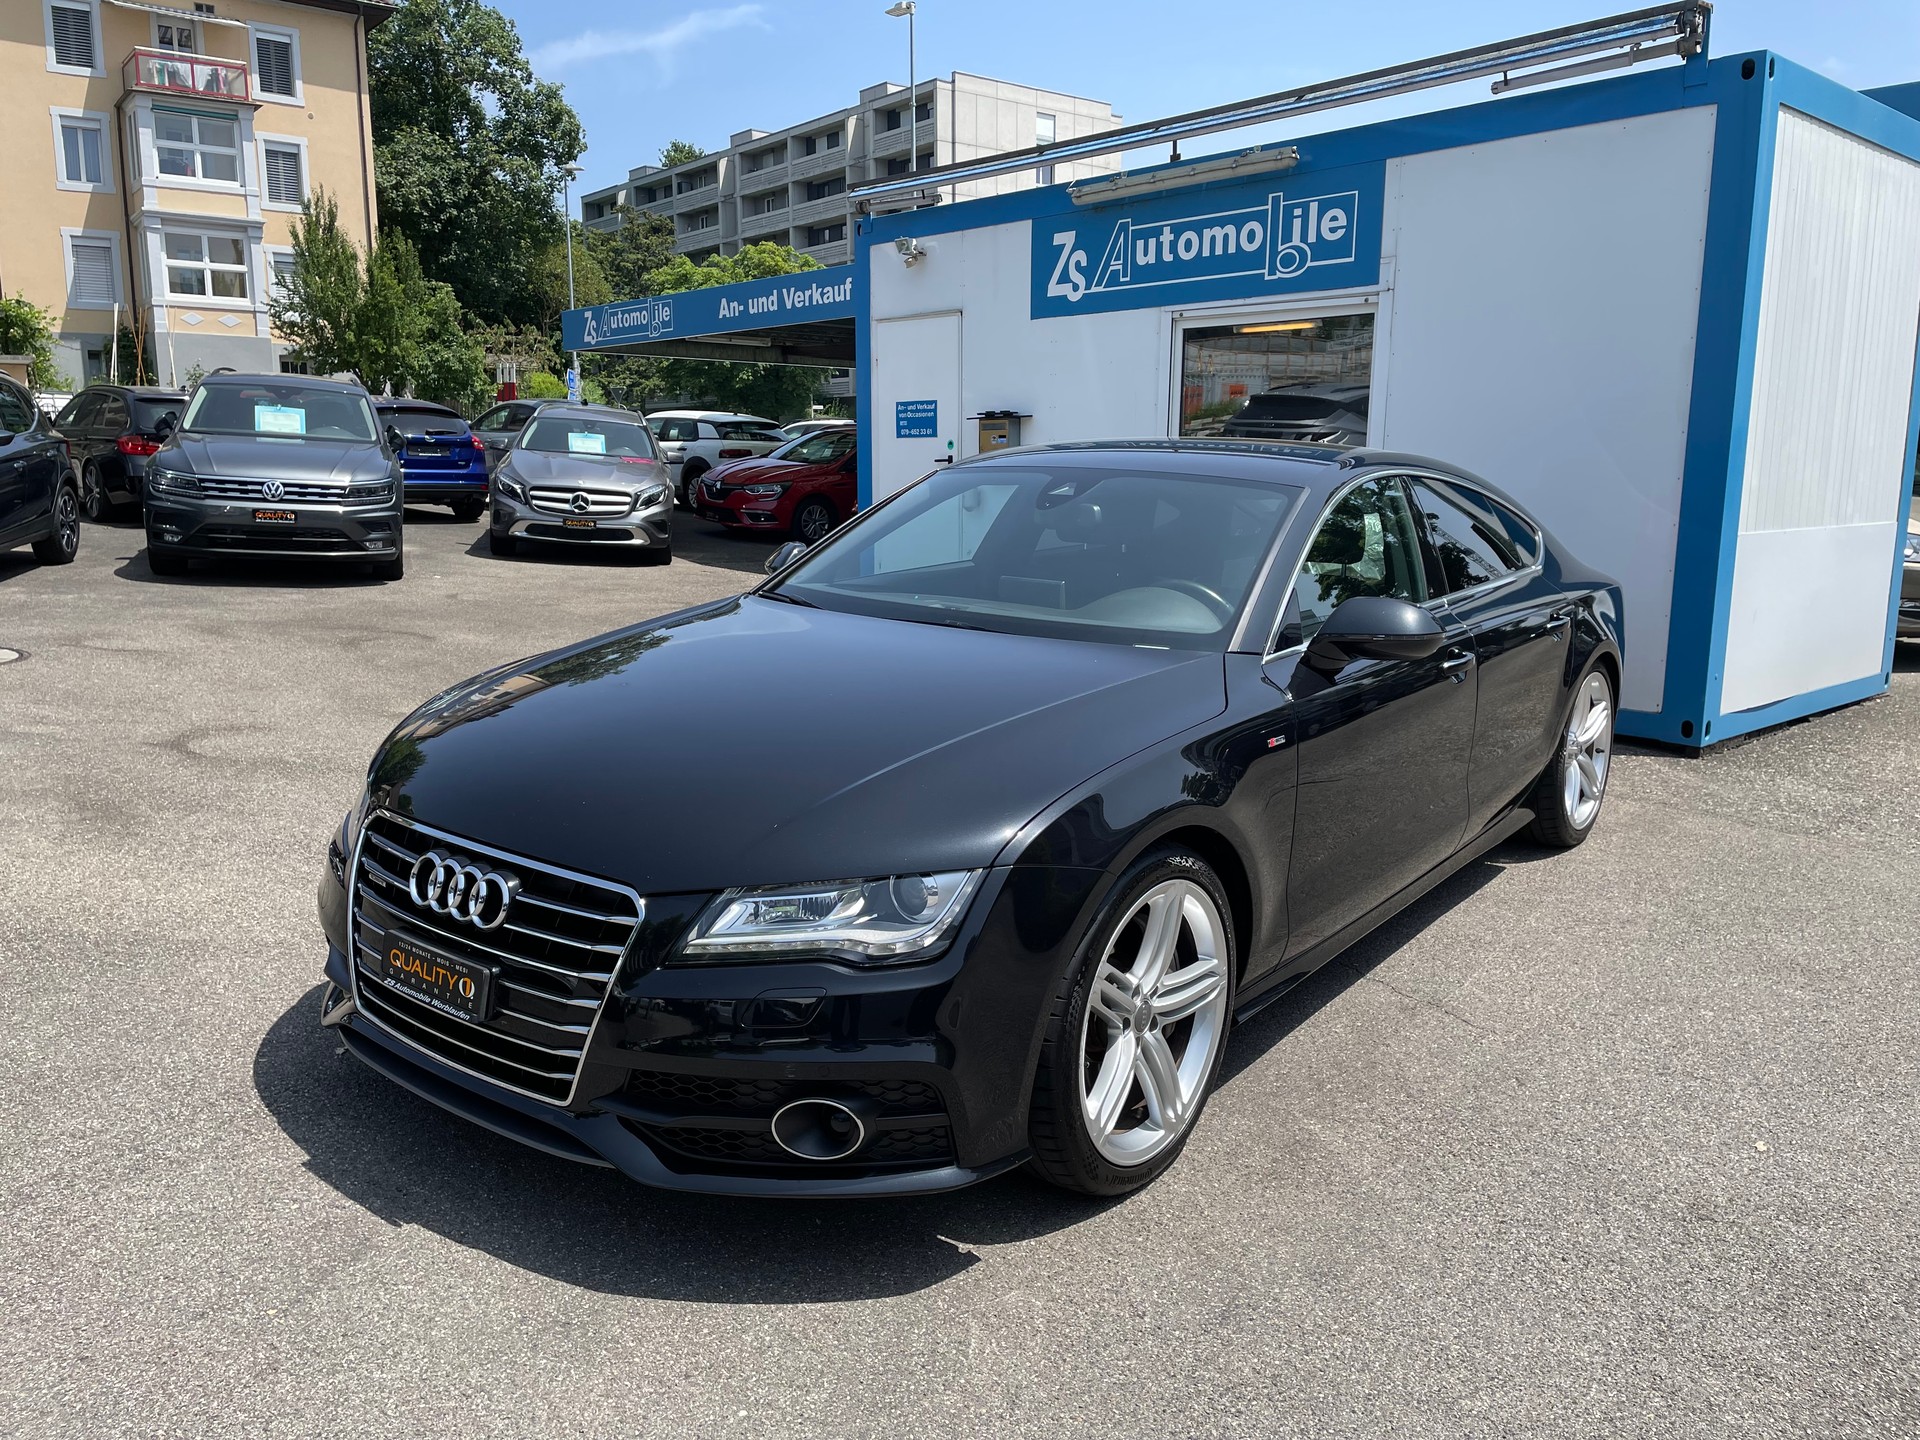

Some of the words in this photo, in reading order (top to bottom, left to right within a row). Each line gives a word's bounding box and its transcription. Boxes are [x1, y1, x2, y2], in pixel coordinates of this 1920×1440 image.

[1089, 191, 1348, 291] Automobile
[598, 298, 671, 339] Automobile
[718, 297, 744, 319] An-
[748, 289, 778, 314] und
[782, 277, 853, 310] Verkauf
[390, 948, 459, 990] QUALITY
[411, 946, 431, 960] MONATE
[436, 957, 450, 967] MOIS
[395, 982, 431, 1003] Automobile
[431, 998, 471, 1021] Worblaufen
